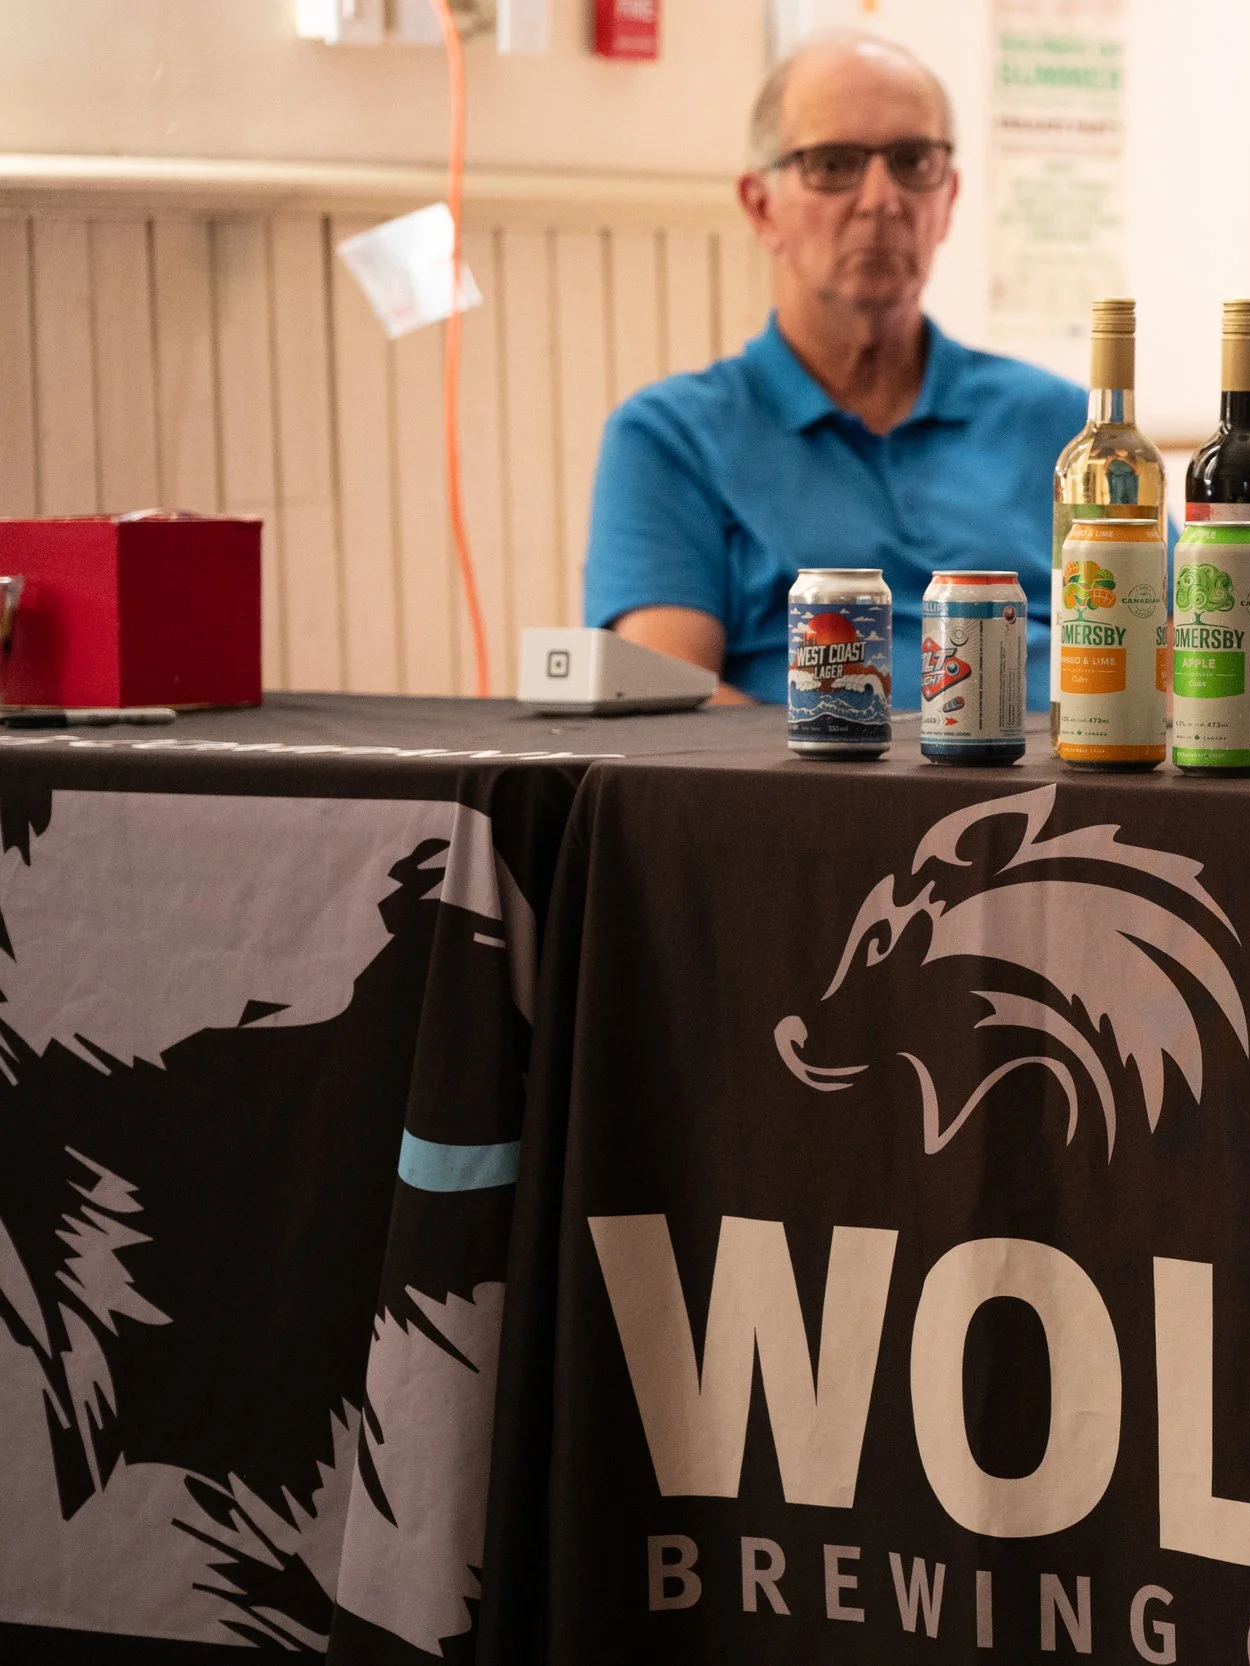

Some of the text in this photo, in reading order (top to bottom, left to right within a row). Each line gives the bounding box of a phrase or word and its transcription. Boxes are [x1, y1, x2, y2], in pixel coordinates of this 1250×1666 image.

[1062, 624, 1126, 647] OMERSBY
[1173, 627, 1245, 649] OMERSBY
[797, 641, 867, 667] WEST COAST
[1083, 657, 1089, 665] &
[1092, 657, 1116, 666] LIME
[1182, 658, 1216, 669] APPLE
[814, 664, 843, 680] LAGER
[646, 1534, 1177, 1665] BREWING
